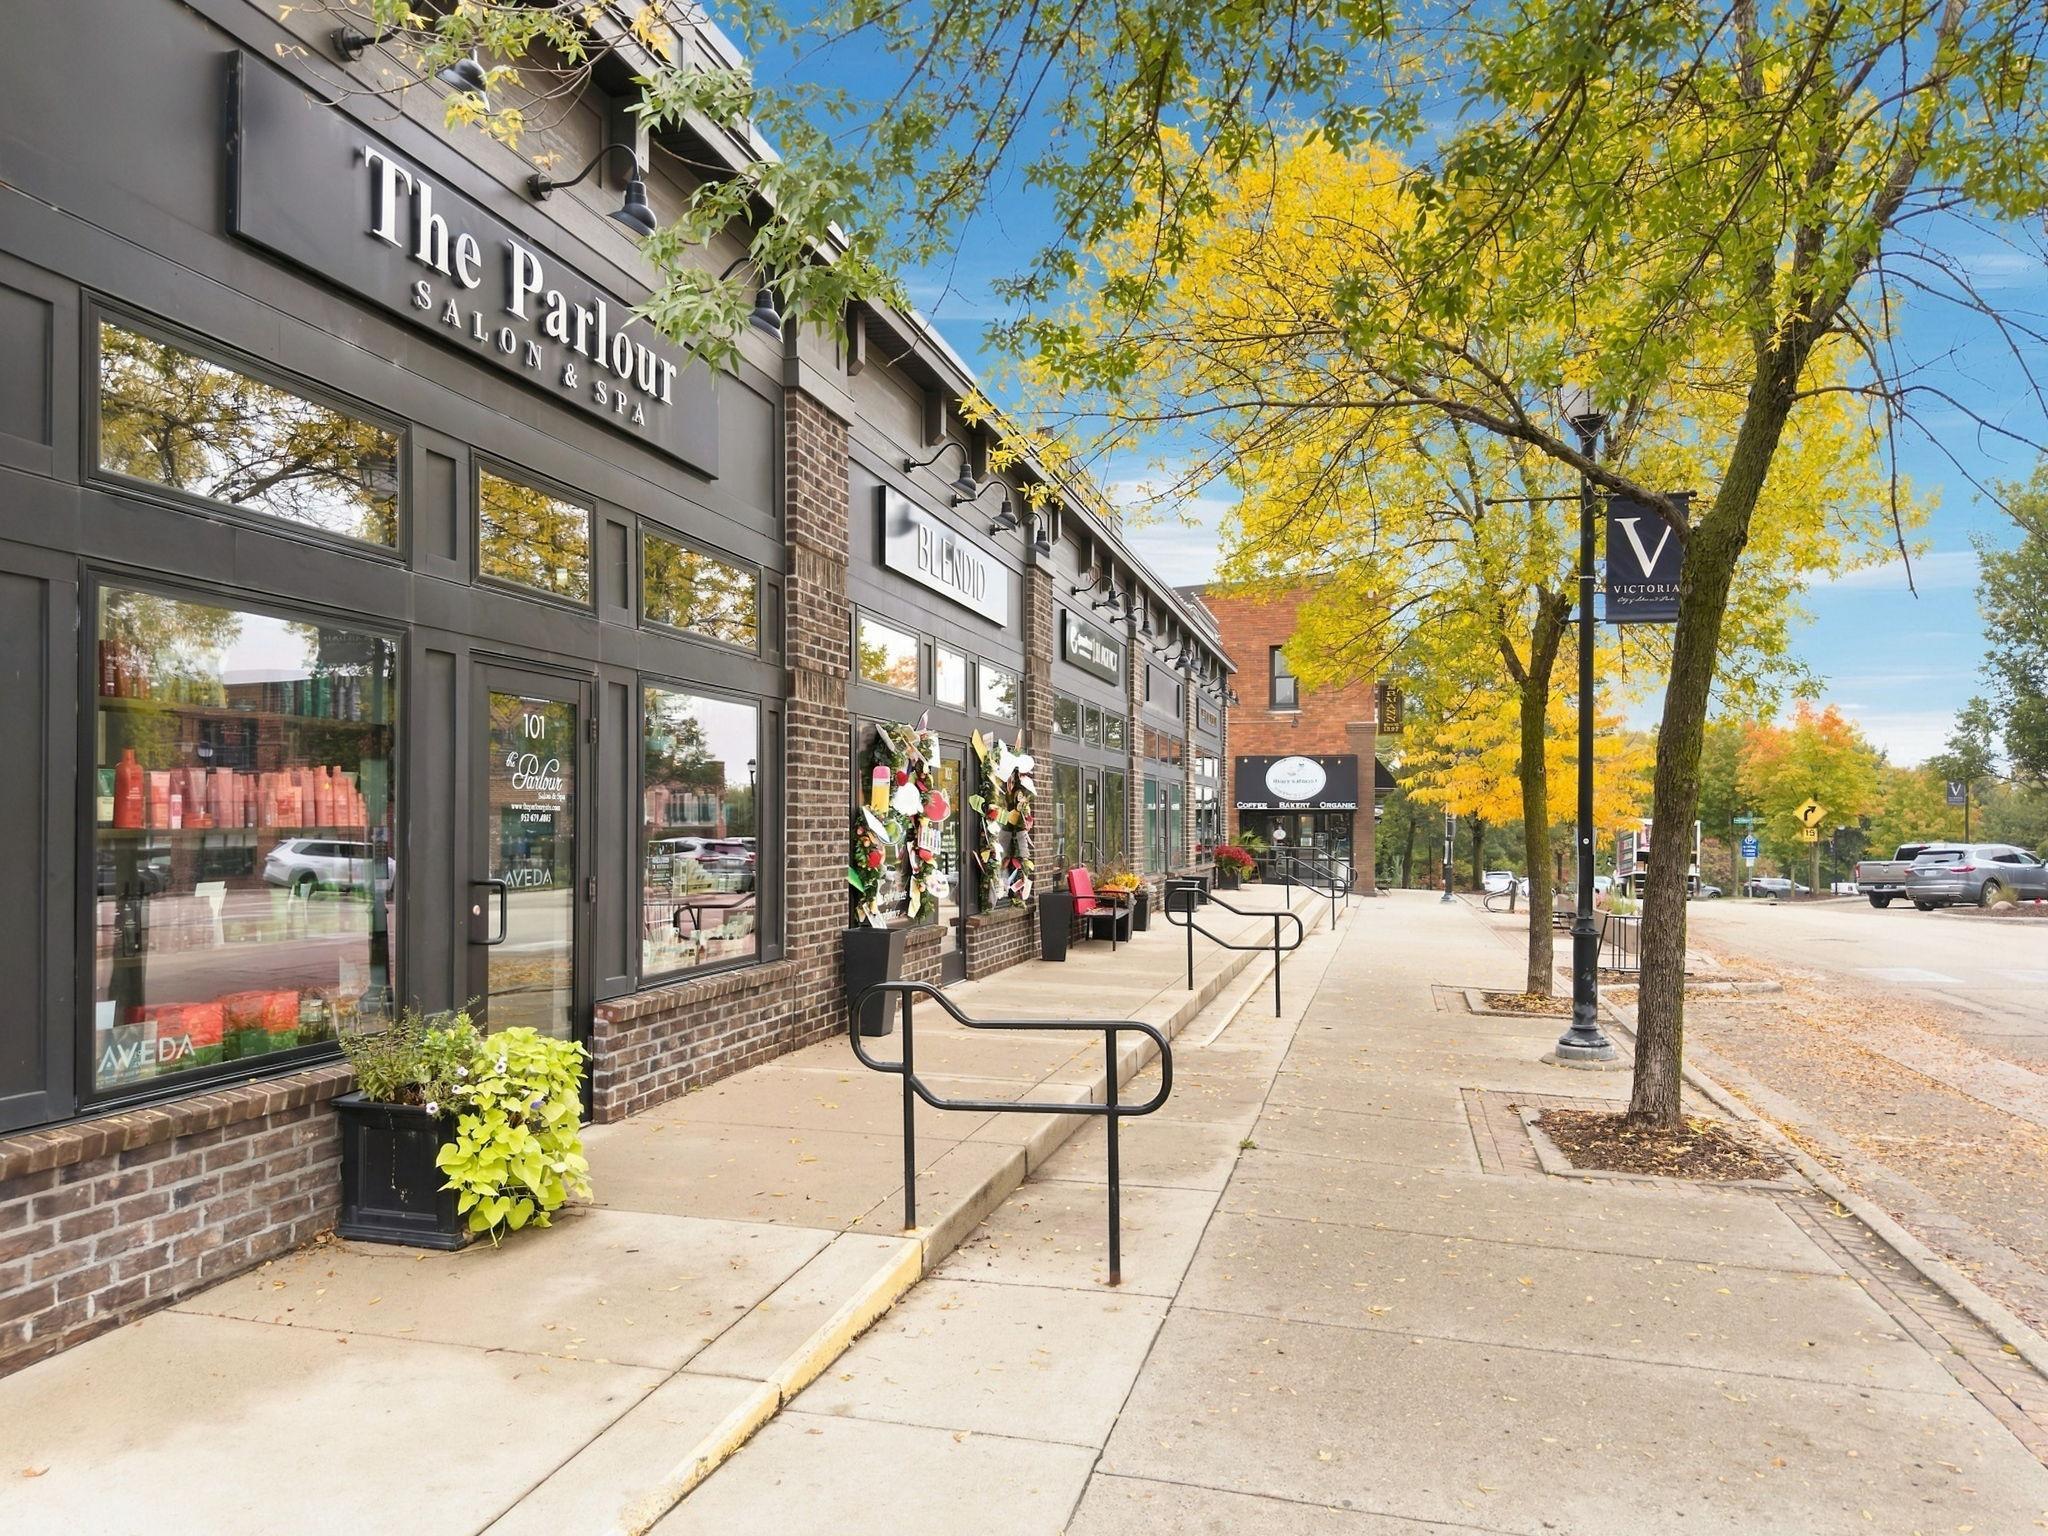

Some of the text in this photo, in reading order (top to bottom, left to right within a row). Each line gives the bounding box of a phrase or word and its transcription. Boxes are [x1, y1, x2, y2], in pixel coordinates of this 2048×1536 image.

[365, 145, 677, 405] The Parlour
[416, 280, 645, 426] SALON & SPA
[918, 524, 985, 602] BLENDID
[1614, 518, 1672, 578] V
[1614, 584, 1680, 594] VICTORIA
[523, 714, 545, 738] 101
[512, 754, 562, 791] Parlour
[1806, 829, 1815, 837] 15
[505, 869, 552, 887] AVEDA
[98, 1034, 195, 1073] AVEDA
